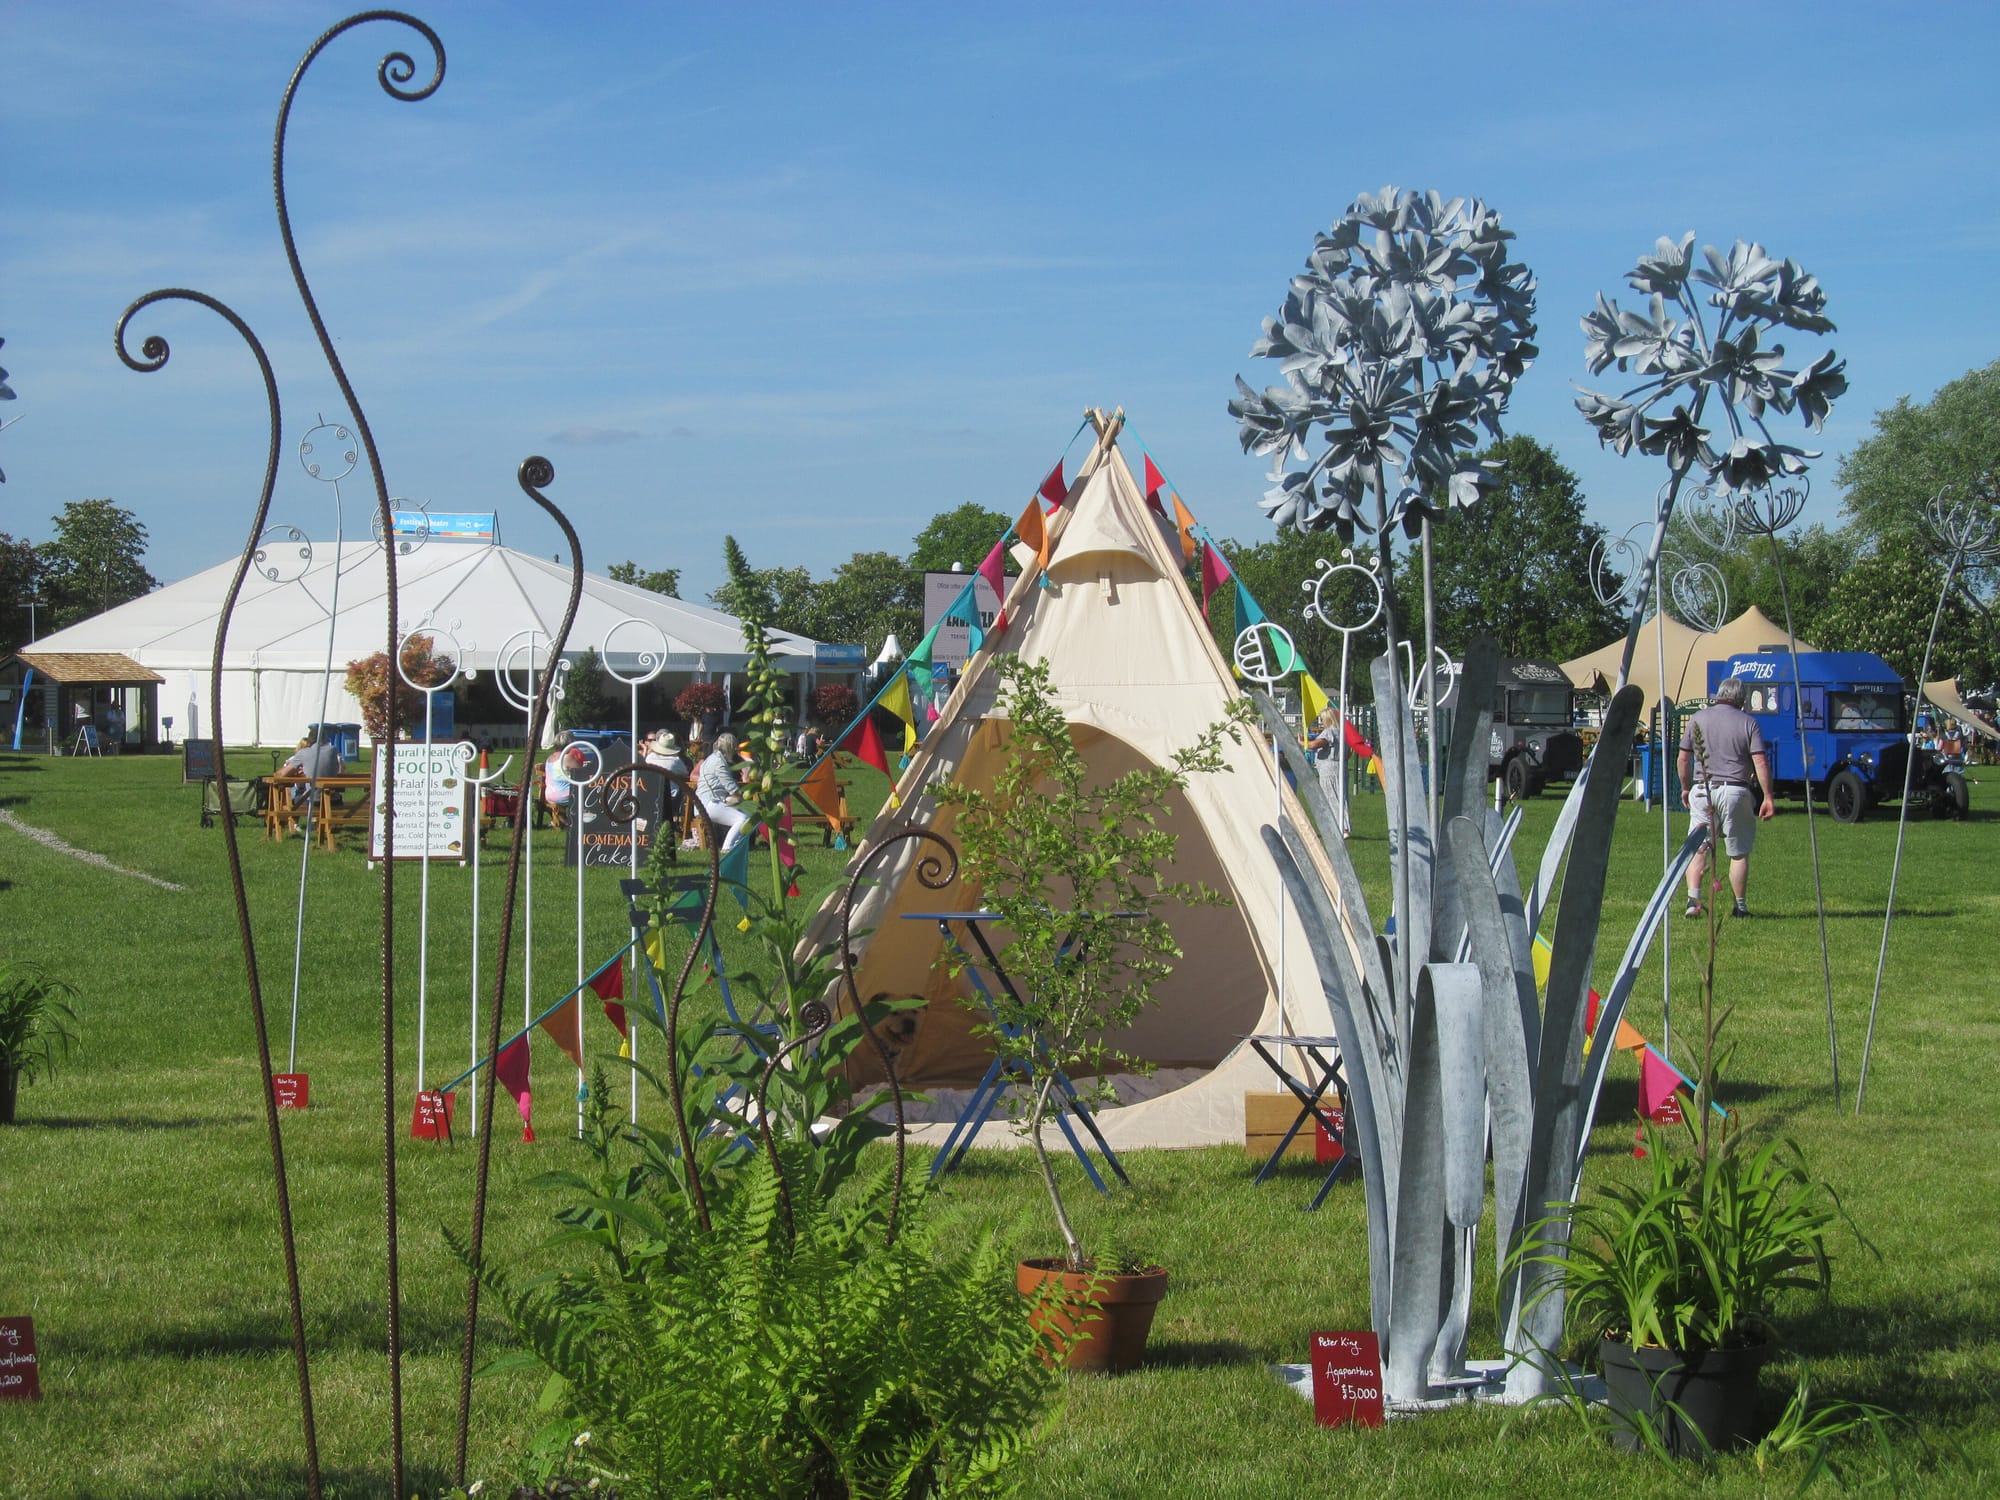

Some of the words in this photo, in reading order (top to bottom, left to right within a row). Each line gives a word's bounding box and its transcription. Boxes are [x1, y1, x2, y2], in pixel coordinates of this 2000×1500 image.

[1754, 663, 1776, 679] TEAS
[379, 747, 419, 757] Ntural
[400, 779, 439, 788] Falafls
[1318, 1336, 1338, 1347] Peter
[1340, 1336, 1363, 1356] King
[1326, 1361, 1374, 1386] Agapanthus
